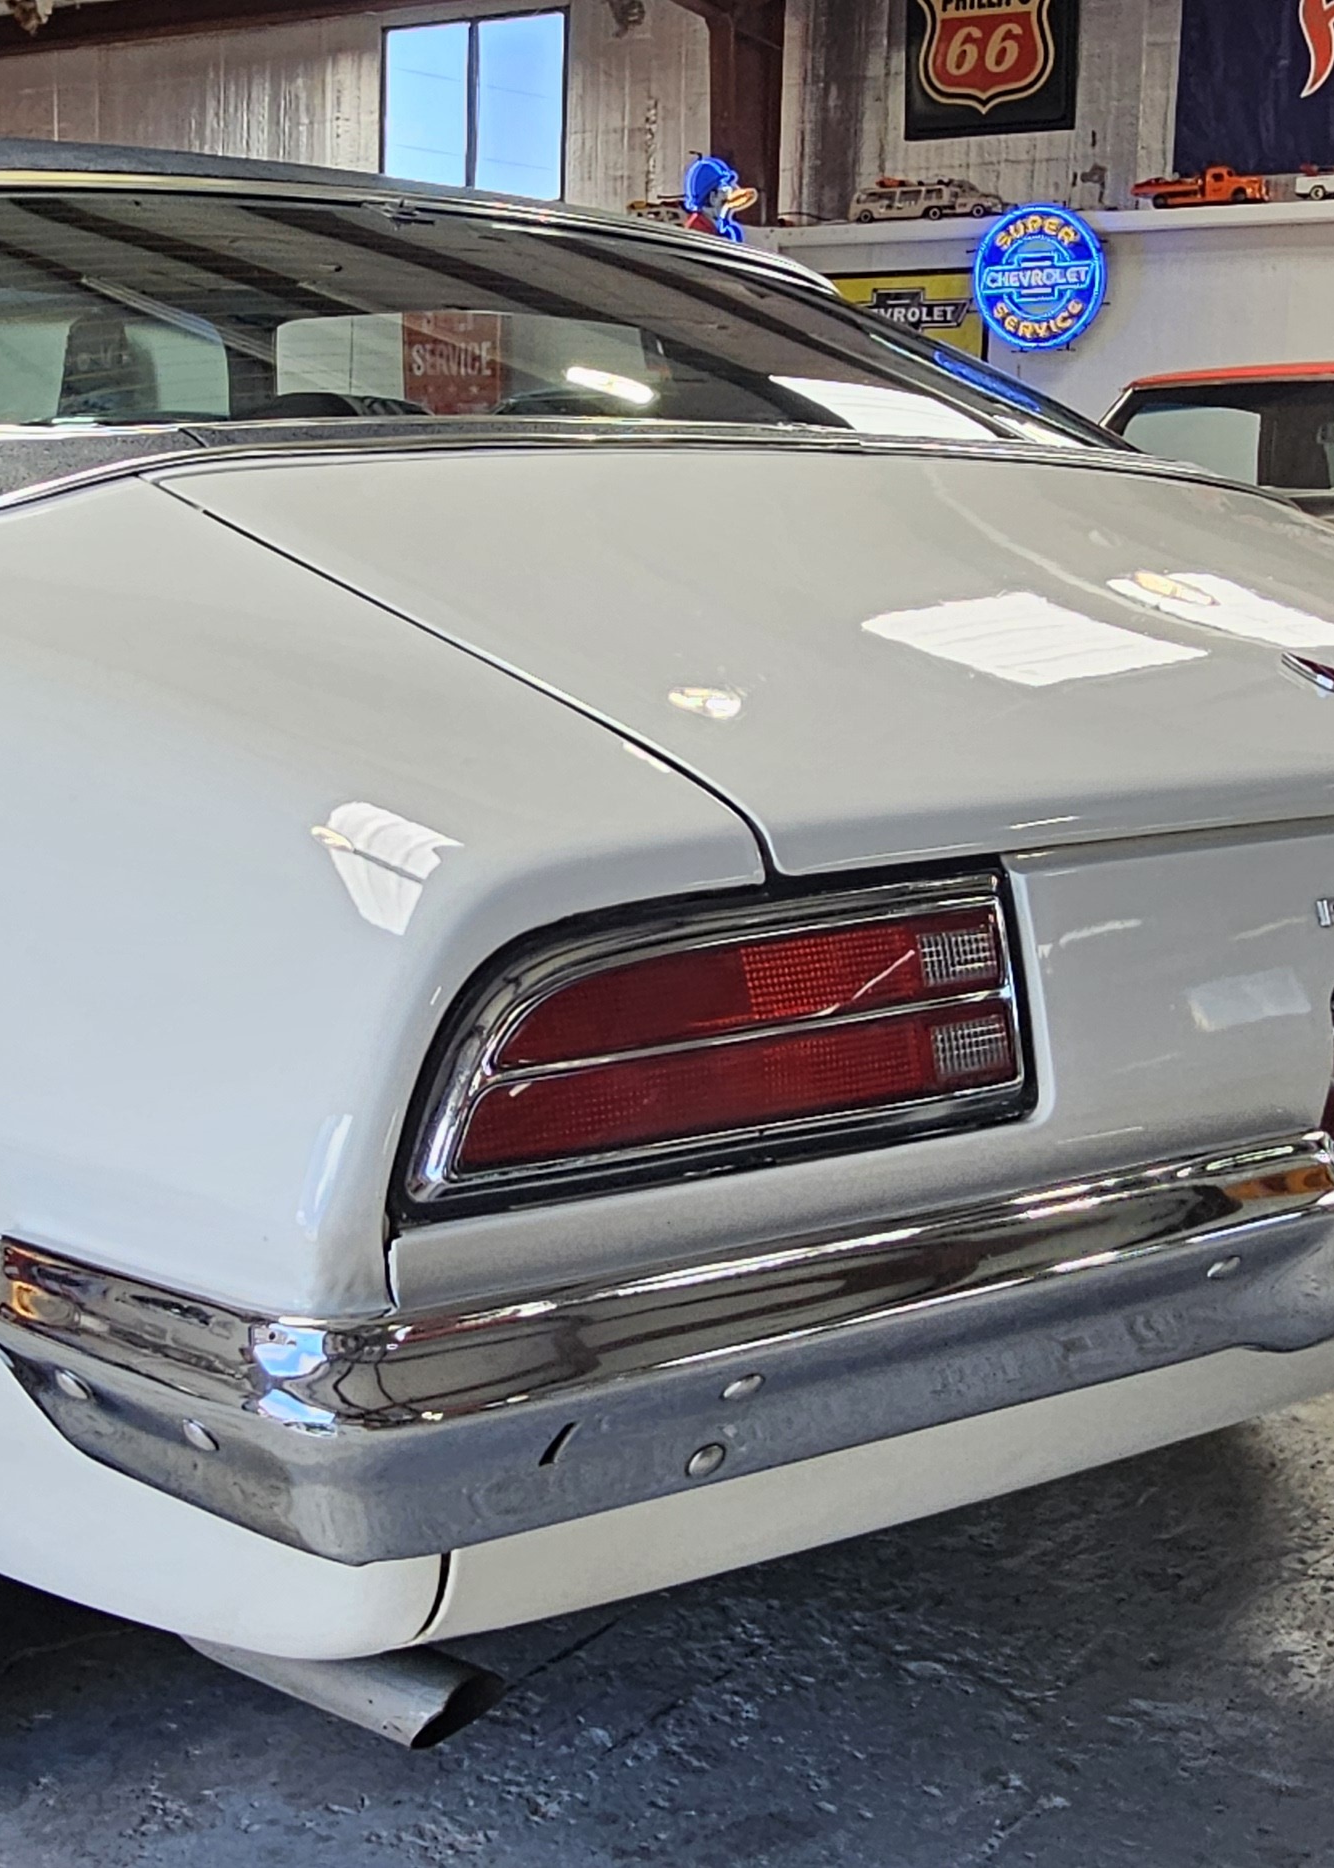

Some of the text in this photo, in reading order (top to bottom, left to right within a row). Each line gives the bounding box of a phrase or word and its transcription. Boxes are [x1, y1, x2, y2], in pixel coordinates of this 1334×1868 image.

[942, 0, 1031, 12] PHILL
[946, 23, 1023, 76] 66
[995, 215, 1081, 251] SUPER
[986, 266, 1089, 289] CHEVROLET
[870, 306, 955, 323] VROLET
[993, 299, 1084, 338] SERVICE
[411, 340, 492, 377] SERVICE
